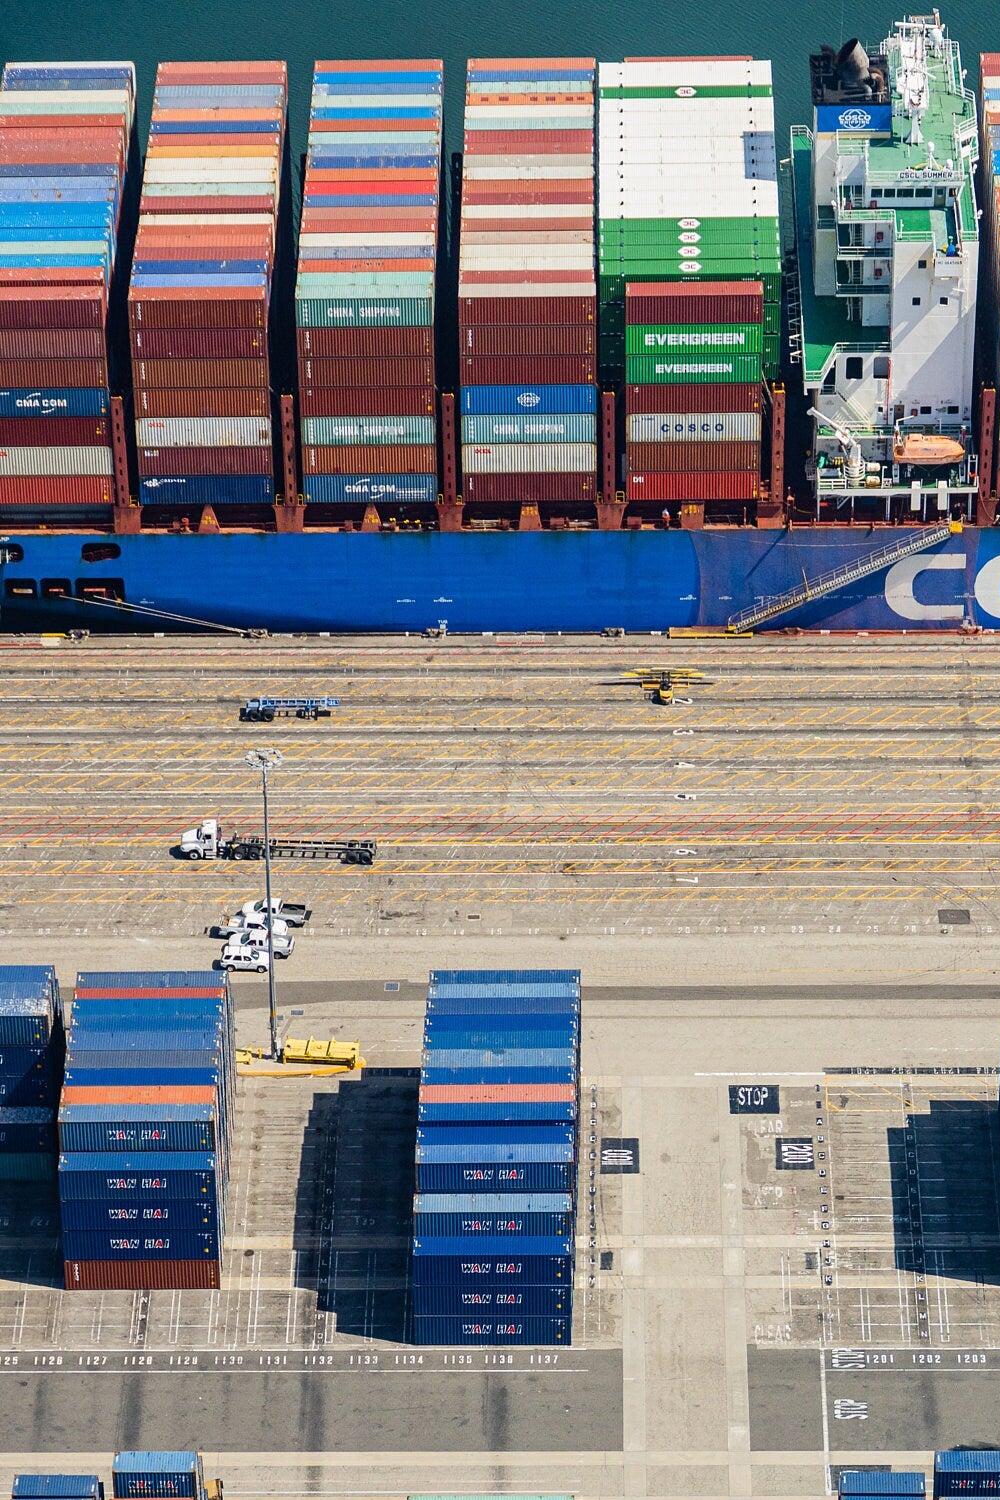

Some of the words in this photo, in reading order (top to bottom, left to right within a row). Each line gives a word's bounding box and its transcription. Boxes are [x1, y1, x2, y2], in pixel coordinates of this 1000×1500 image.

[327, 307, 353, 317] CHINA
[359, 307, 400, 317] SHIPPING
[644, 333, 745, 346] EVERGREEN
[655, 363, 733, 374] EVERGREEN
[16, 399, 39, 407] CMA
[42, 399, 67, 407] CGM
[333, 425, 359, 436] CHINA
[363, 425, 404, 436] SHIPPING
[493, 424, 520, 435] CHINA
[525, 424, 565, 435] SHIPPING
[345, 484, 368, 493] CMA
[370, 484, 395, 493] CGM
[738, 1087, 769, 1106] STOP
[107, 1130, 136, 1140] WAN
[139, 1130, 166, 1140] HAI
[781, 1143, 814, 1164] 1200
[464, 1170, 493, 1180] WAN
[499, 1170, 524, 1180] HAI
[461, 1263, 491, 1273] WAN
[496, 1263, 522, 1273] HAI
[462, 1325, 492, 1334] WAN
[497, 1325, 522, 1334] HAI
[34, 1356, 63, 1365] 1126
[78, 1356, 107, 1365] 1127
[259, 1356, 287, 1365] 1131
[350, 1355, 378, 1365] 1133
[395, 1355, 423, 1364] 1134
[485, 1355, 513, 1364] 1136
[530, 1355, 559, 1364] 1137
[866, 1353, 894, 1363] 1201
[912, 1353, 941, 1363] 1202
[957, 1353, 986, 1363] 1203
